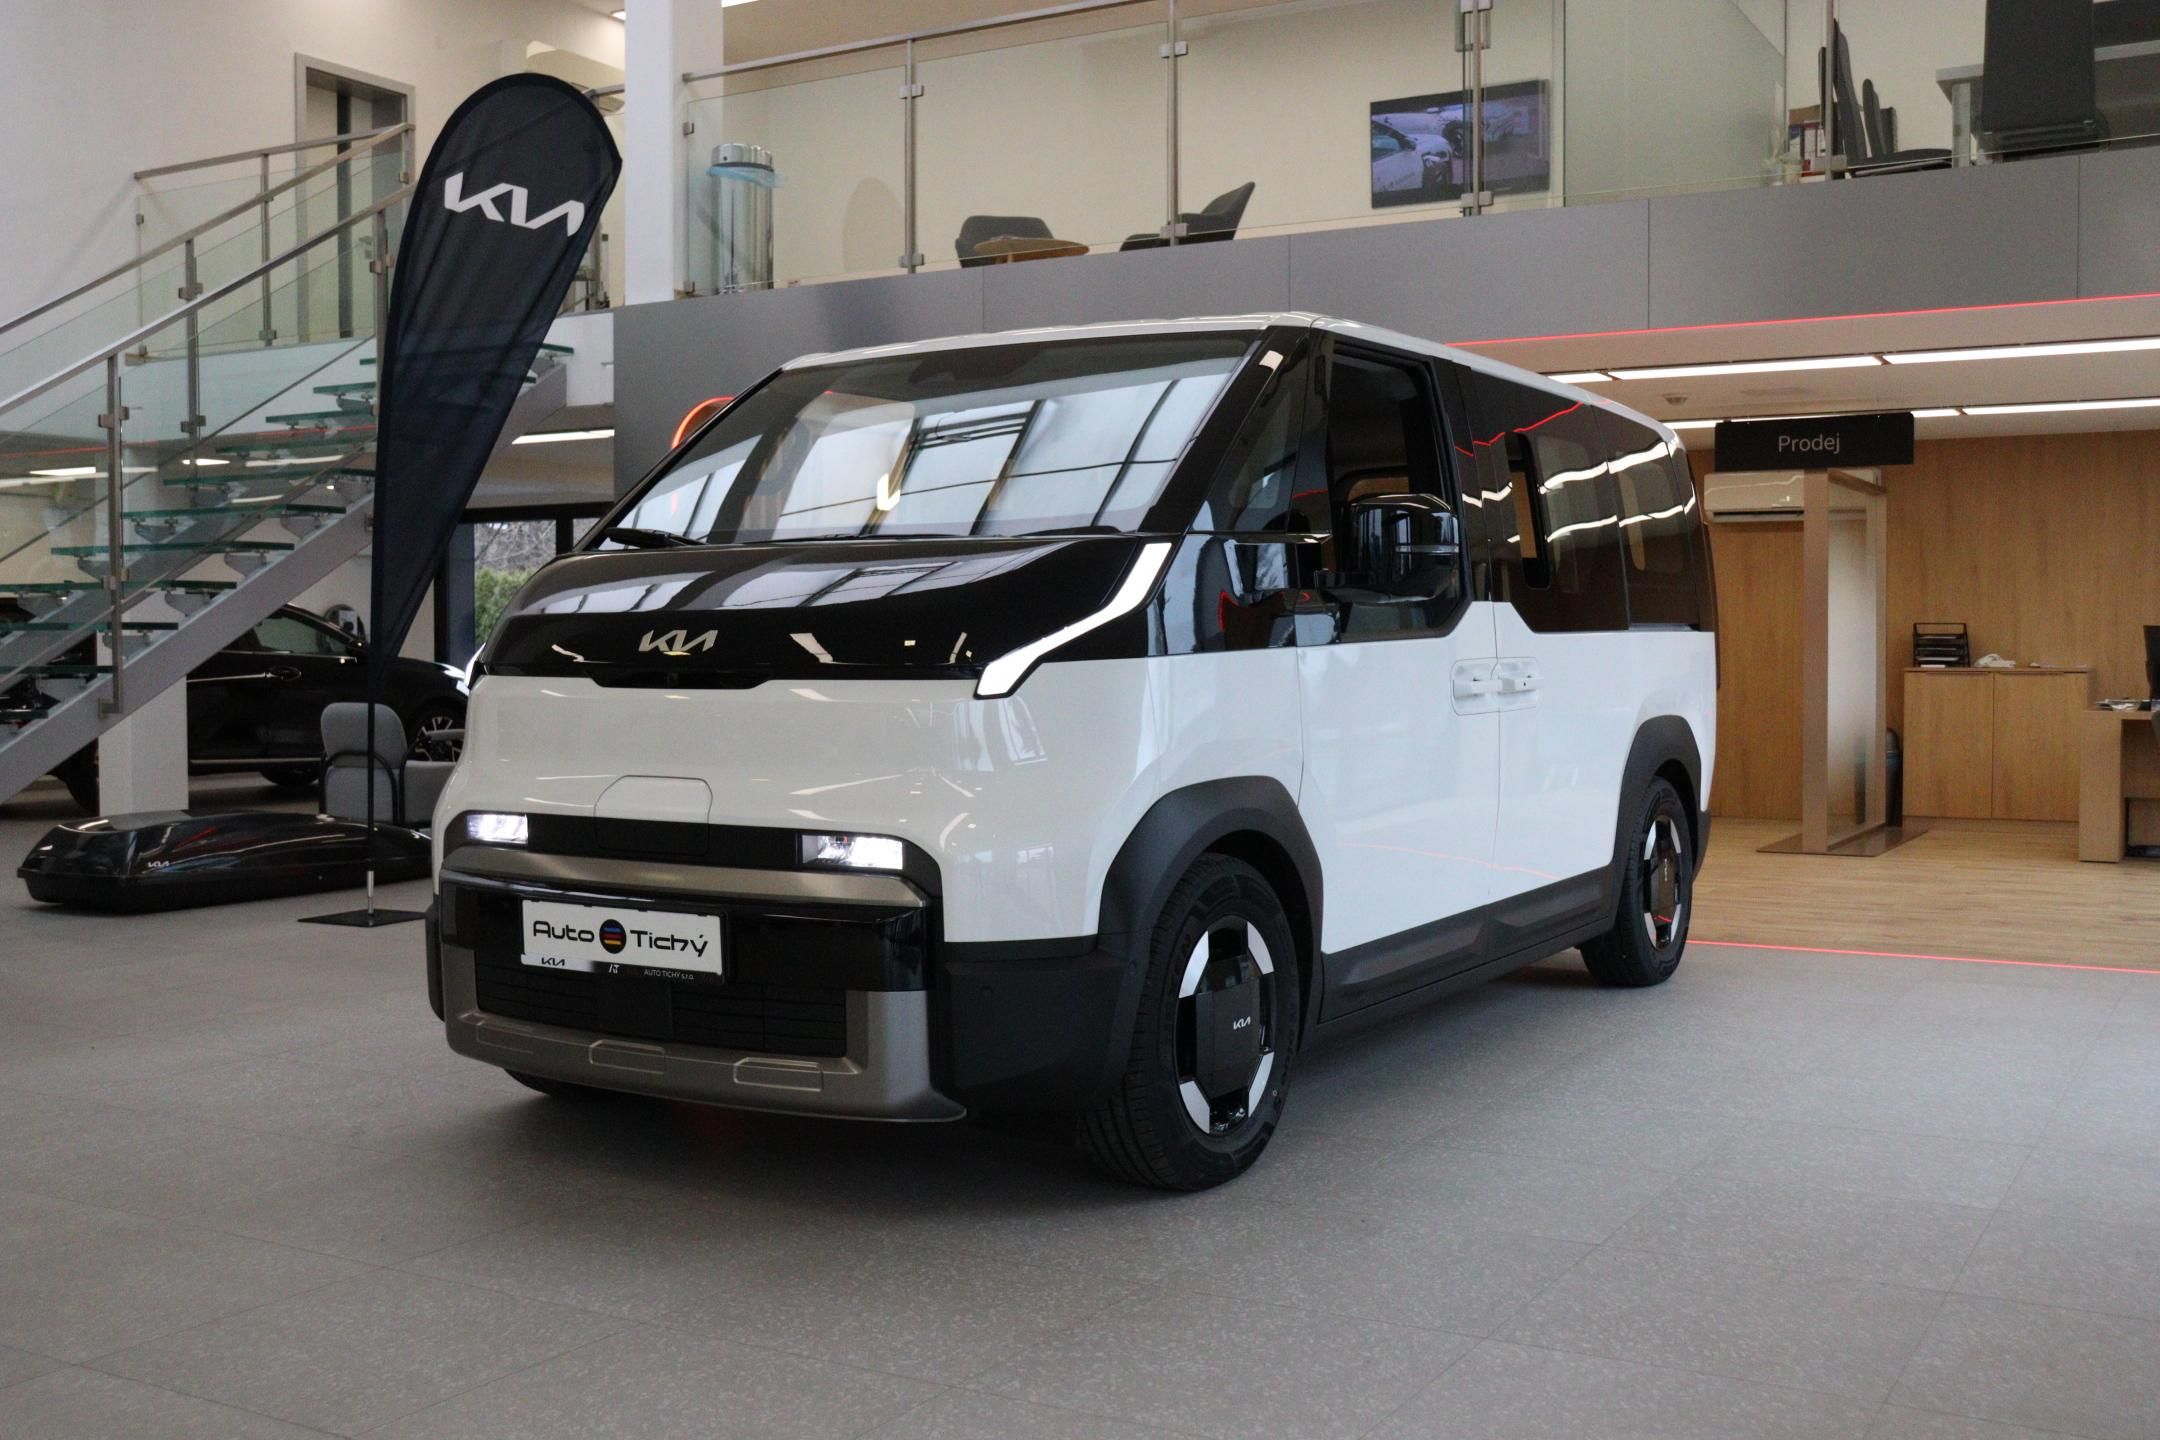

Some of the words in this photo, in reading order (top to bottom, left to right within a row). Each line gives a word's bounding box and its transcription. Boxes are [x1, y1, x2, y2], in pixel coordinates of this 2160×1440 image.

[444, 171, 585, 237] KIA
[1778, 433, 1840, 454] Prodej
[638, 629, 719, 652] KIA
[533, 920, 595, 943] Auto
[630, 929, 708, 957] Tichý
[541, 957, 565, 966] KIA
[643, 968, 661, 977] AUTO
[1233, 1015, 1251, 1030] KIA
